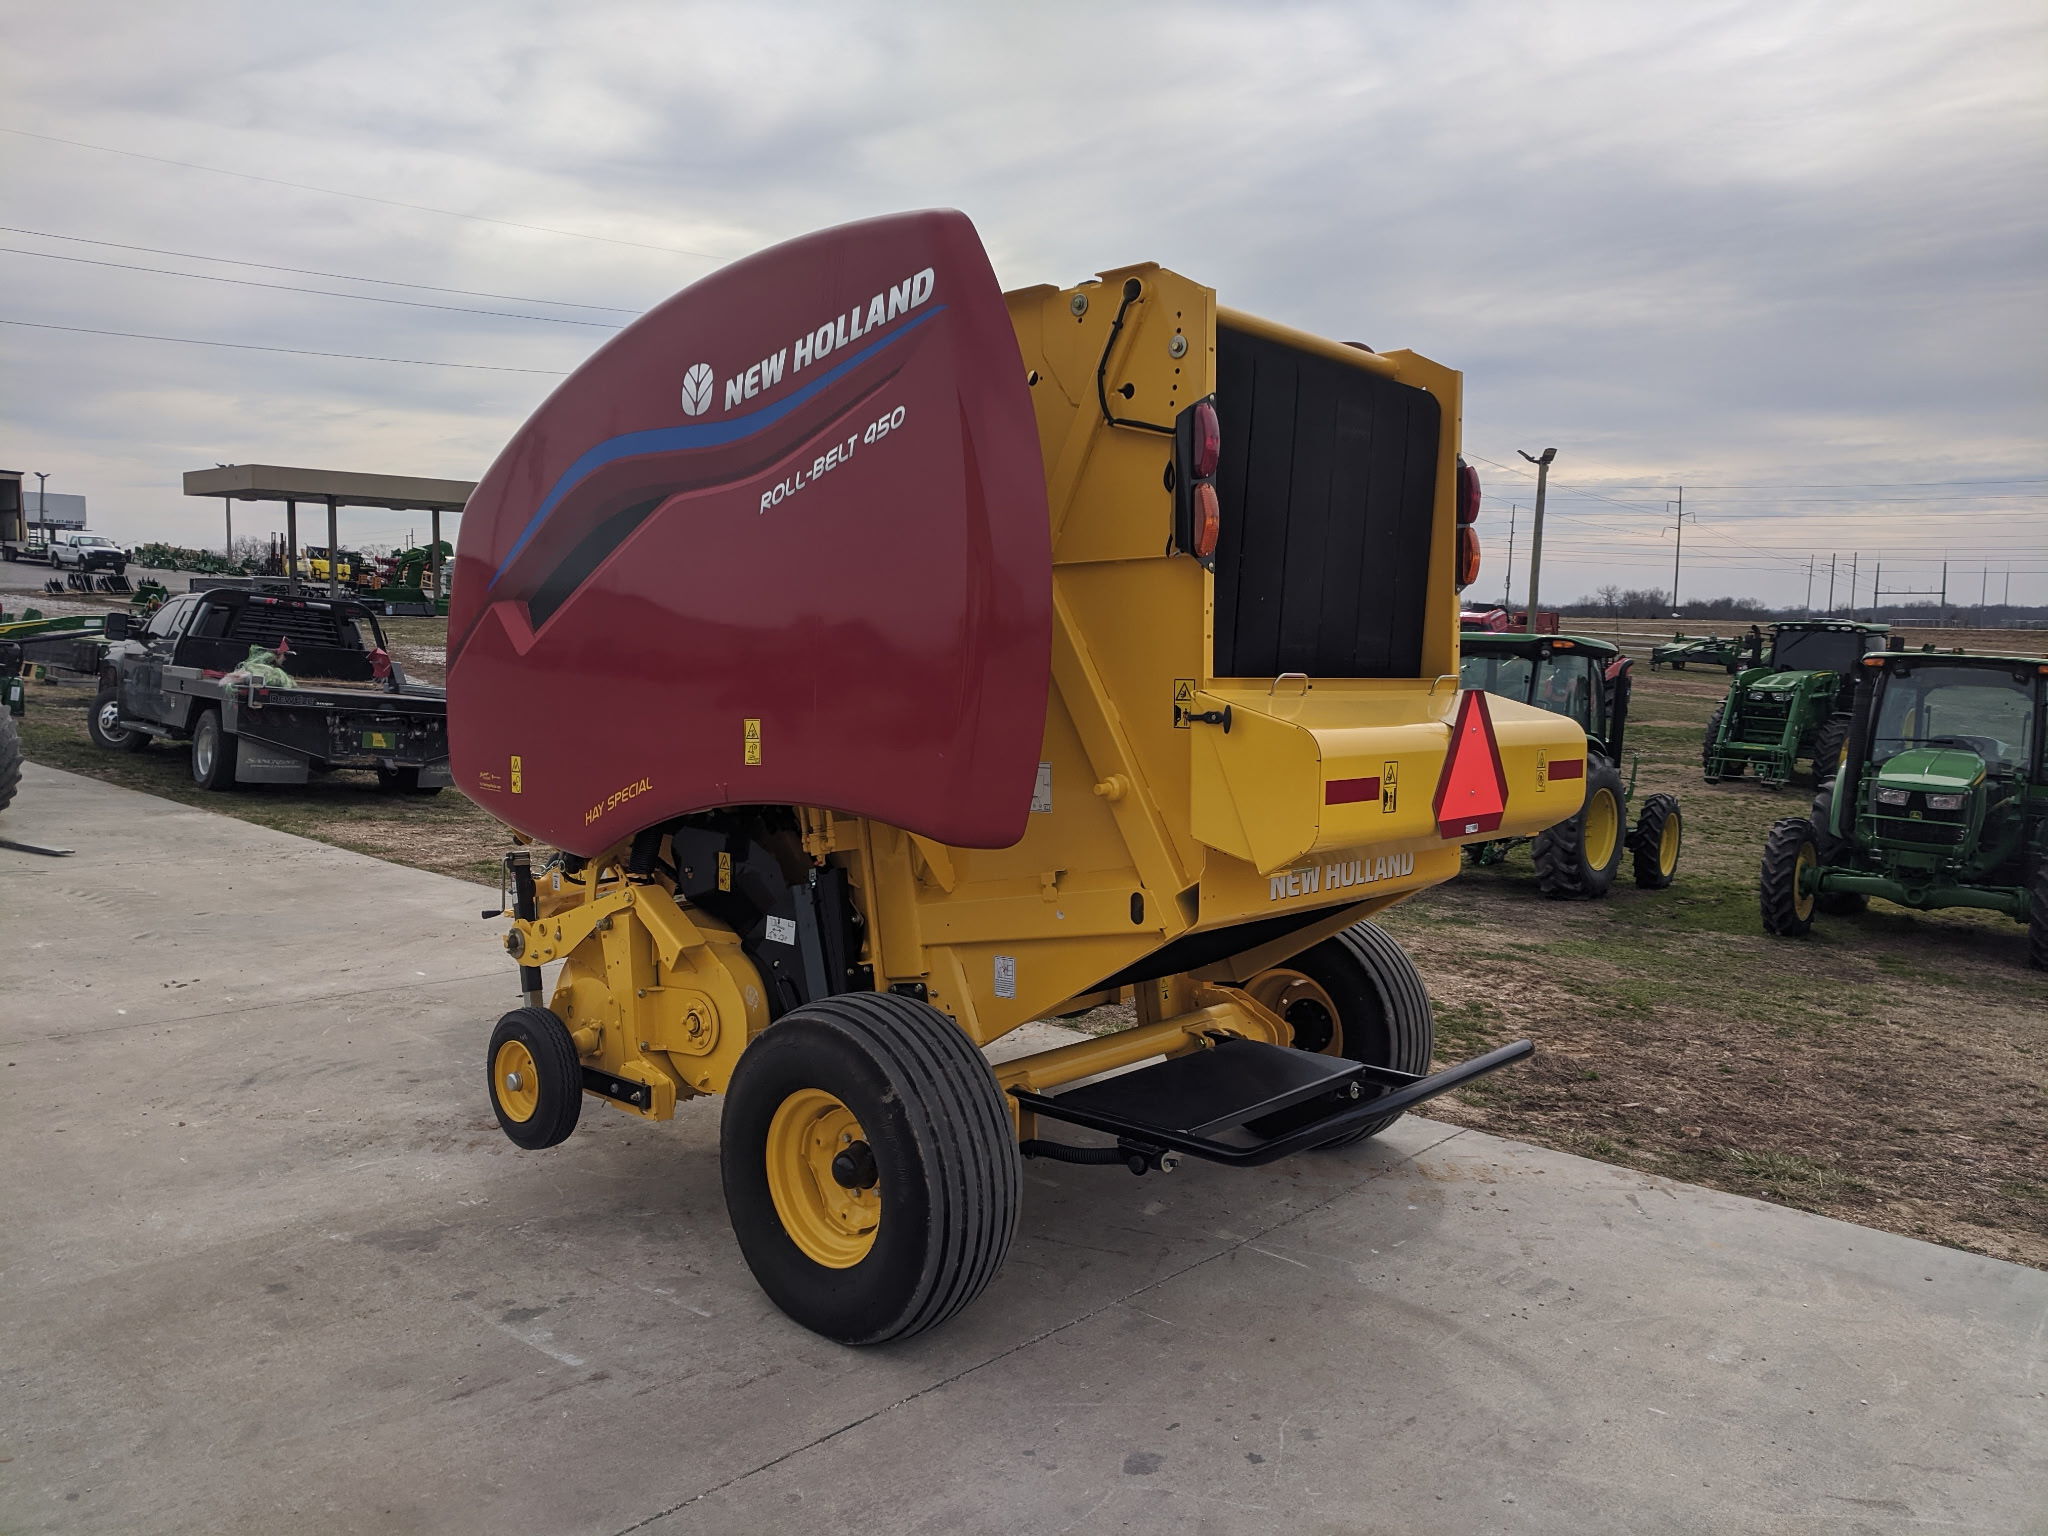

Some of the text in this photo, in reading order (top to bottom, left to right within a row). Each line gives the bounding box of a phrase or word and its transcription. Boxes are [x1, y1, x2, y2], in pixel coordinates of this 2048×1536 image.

[724, 266, 936, 412] NEW HOLLAND
[759, 405, 907, 516] ROLL-BELT 450
[584, 776, 654, 828] HAY SPECIAL
[1270, 851, 1415, 901] NEW HOLLAND
